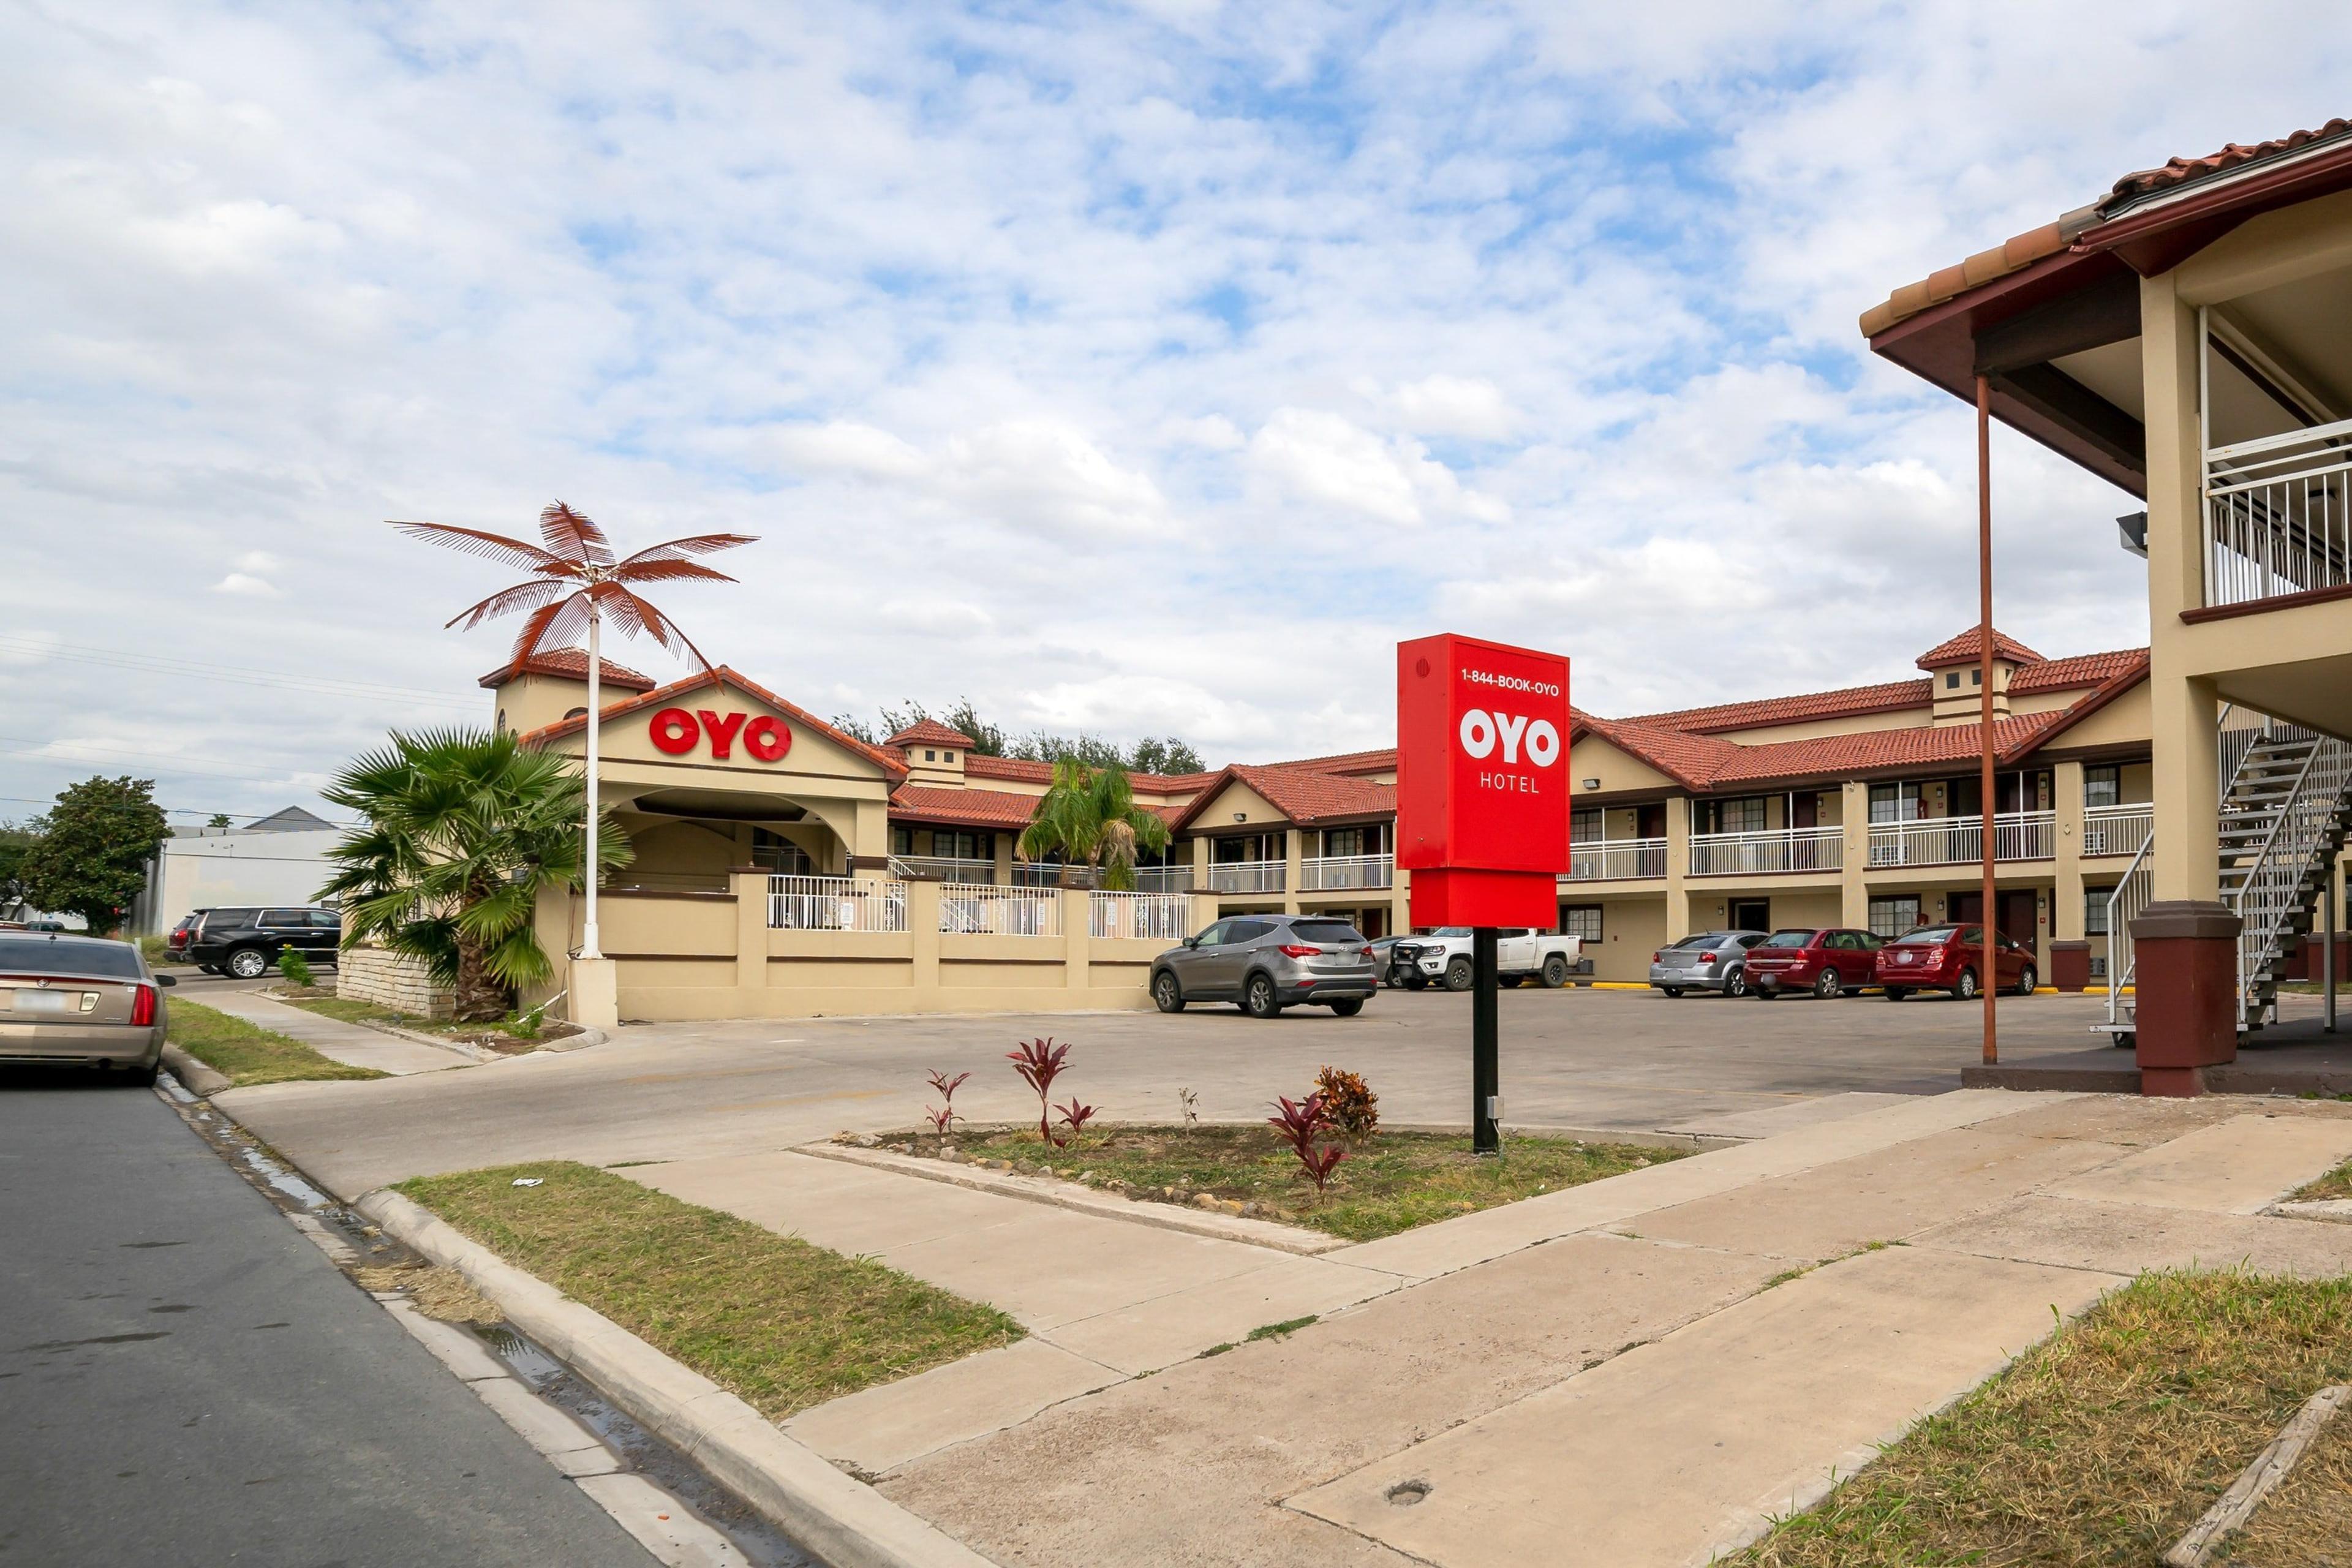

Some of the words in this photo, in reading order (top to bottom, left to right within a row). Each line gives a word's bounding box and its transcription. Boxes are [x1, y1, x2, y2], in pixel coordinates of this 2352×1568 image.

[1461, 668, 1559, 696] 1-844-BOOK-OYO
[649, 707, 792, 762] OYO
[1460, 709, 1560, 767] OYO
[1480, 771, 1539, 794] HOTEL
